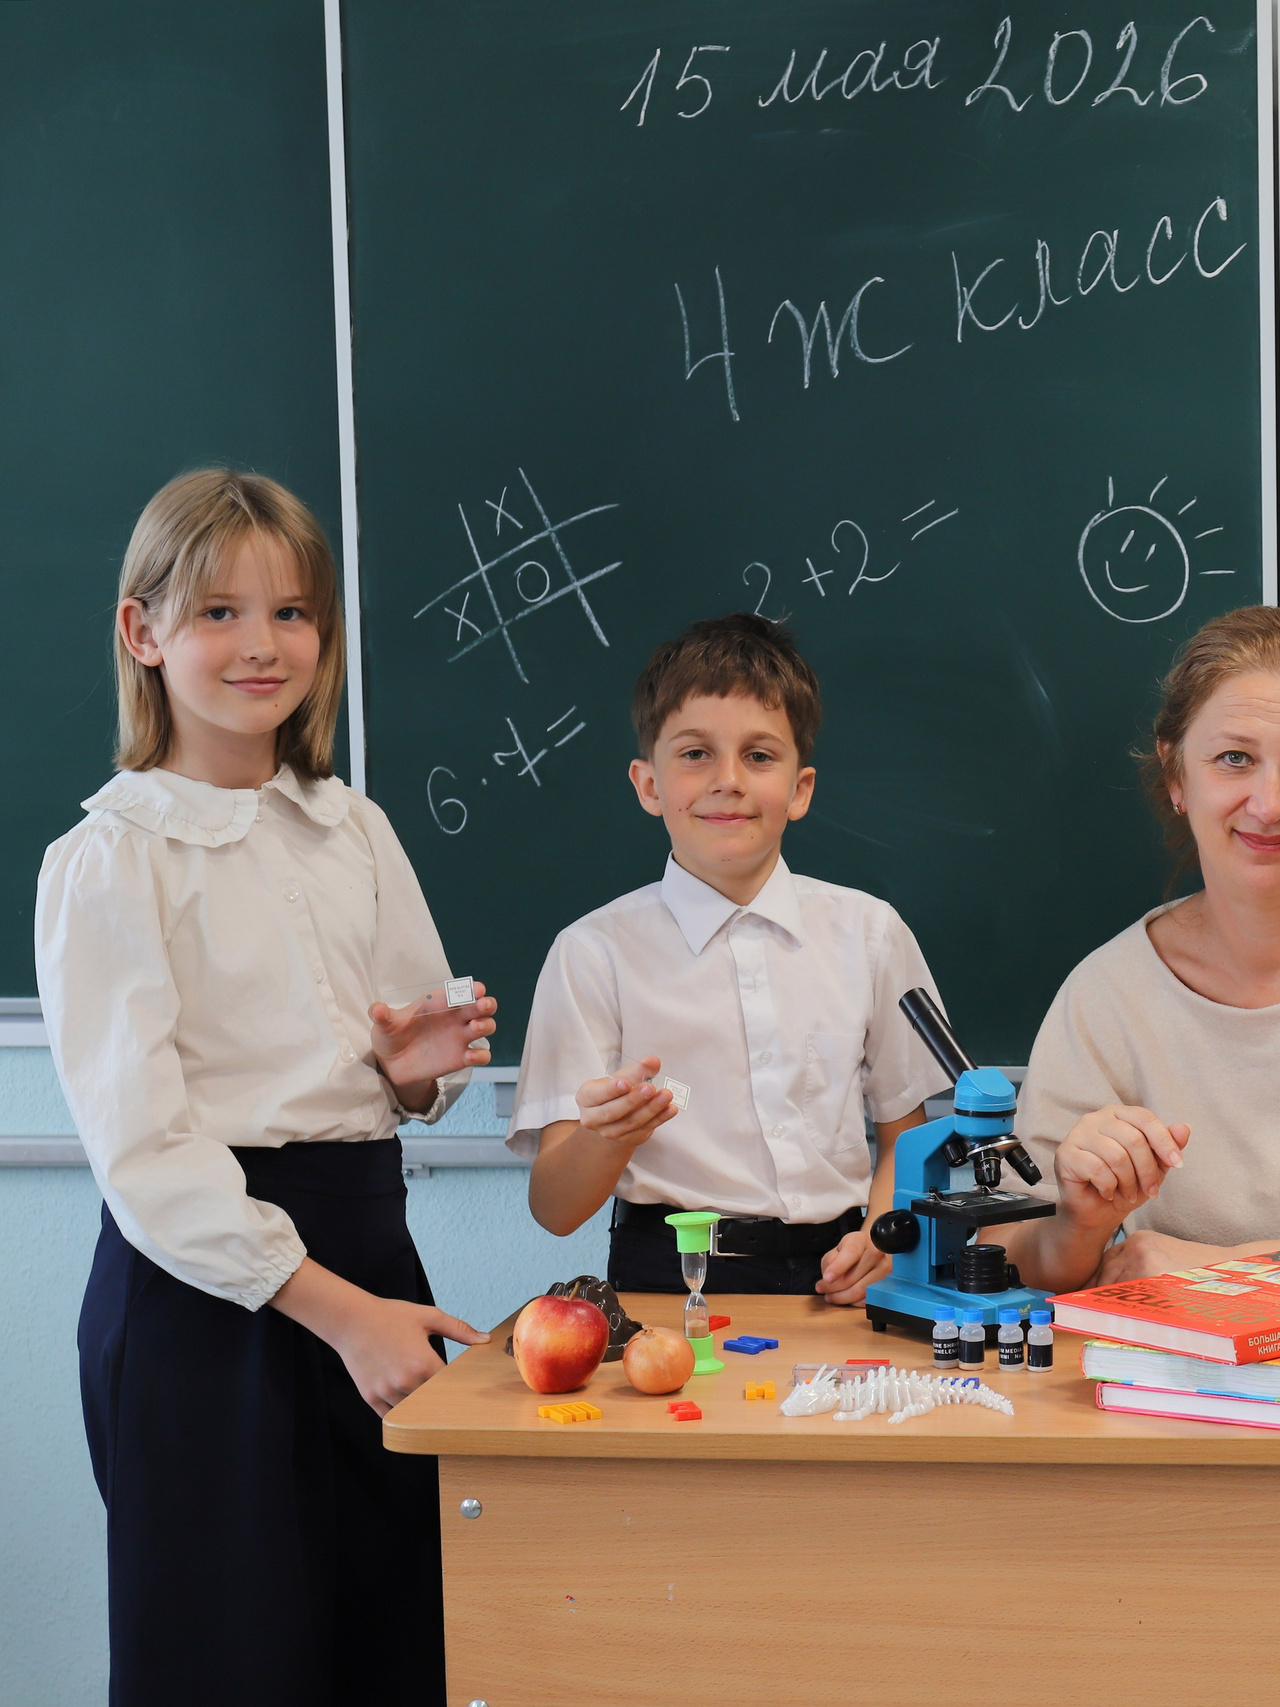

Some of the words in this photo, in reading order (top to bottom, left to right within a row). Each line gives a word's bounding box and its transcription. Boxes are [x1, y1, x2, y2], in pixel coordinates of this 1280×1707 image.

[621, 45, 730, 126] 15
[759, 37, 944, 106] мая
[965, 15, 1215, 112] 2026
[675, 265, 740, 421] 4
